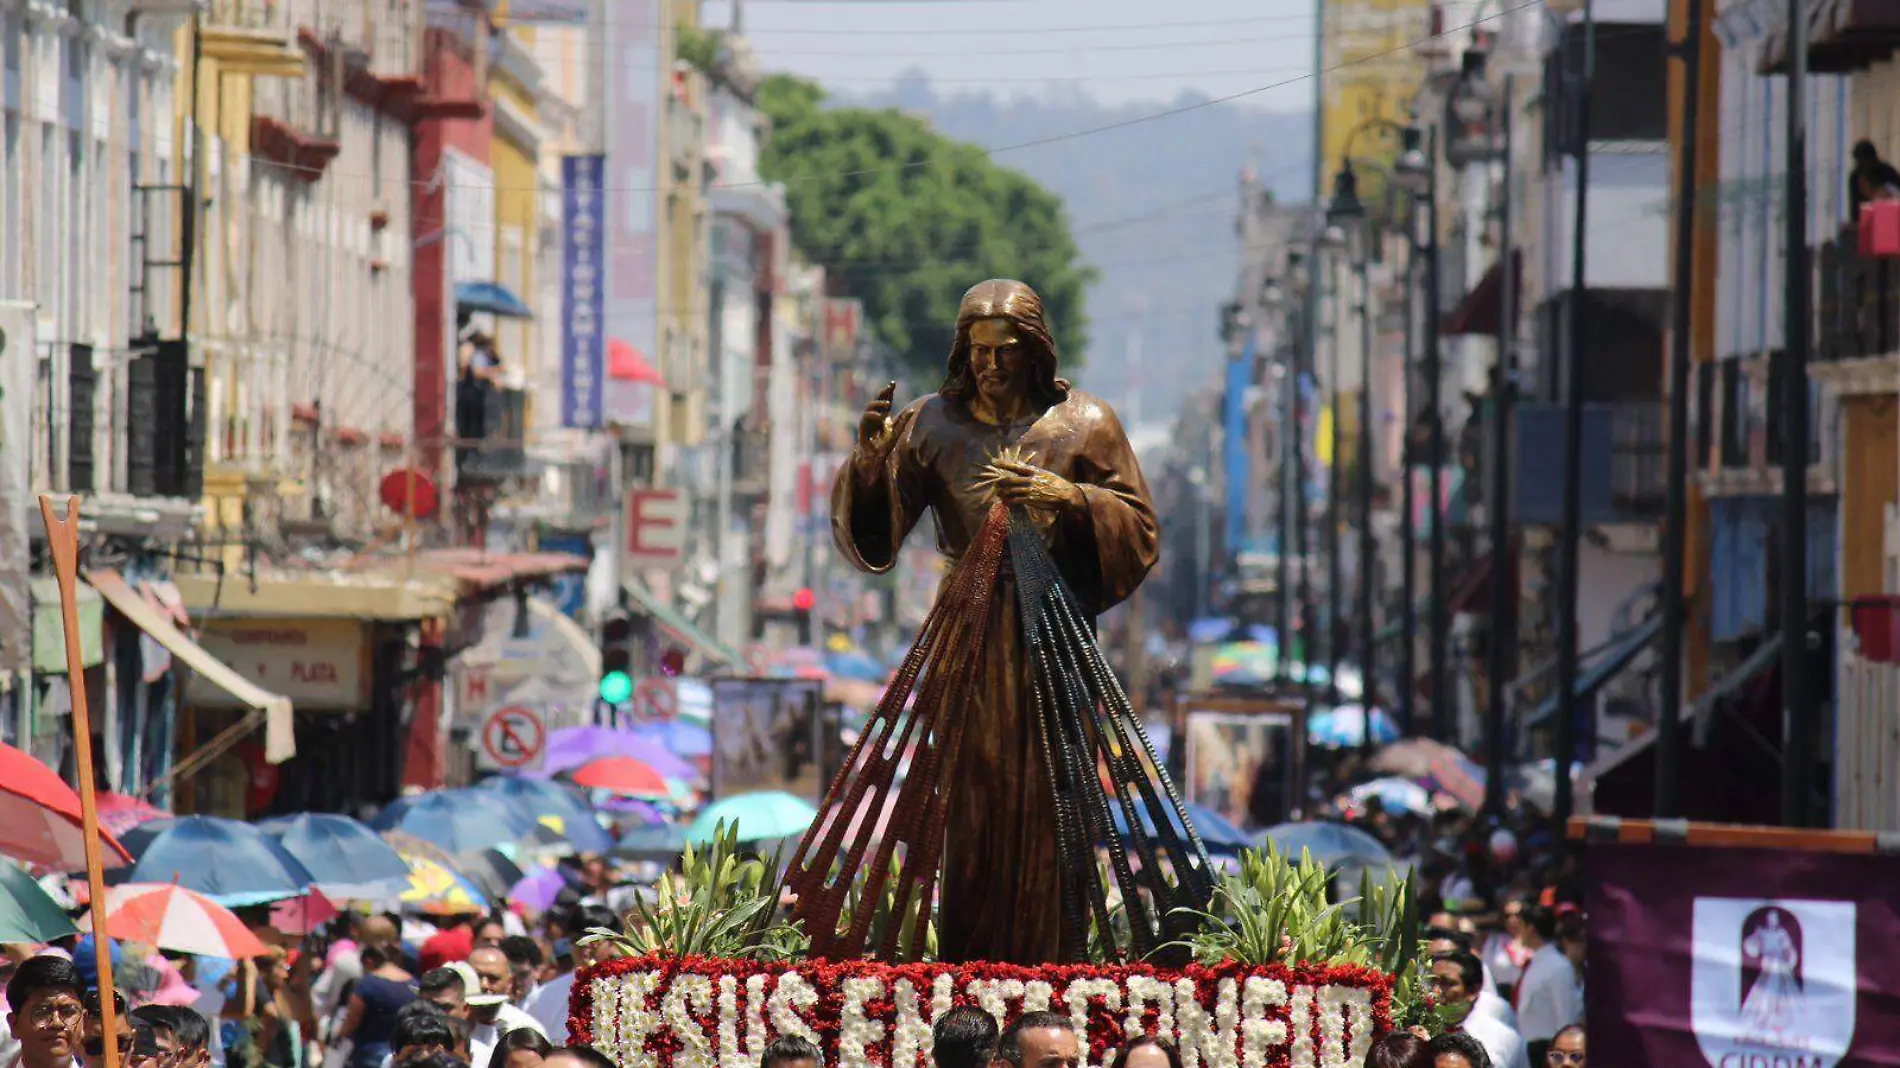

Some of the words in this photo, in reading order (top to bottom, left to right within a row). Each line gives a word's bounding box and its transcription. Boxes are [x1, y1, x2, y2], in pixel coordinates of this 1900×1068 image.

[630, 490, 679, 556] E
[291, 661, 338, 683] PLATA
[592, 972, 823, 1068] JESUS
